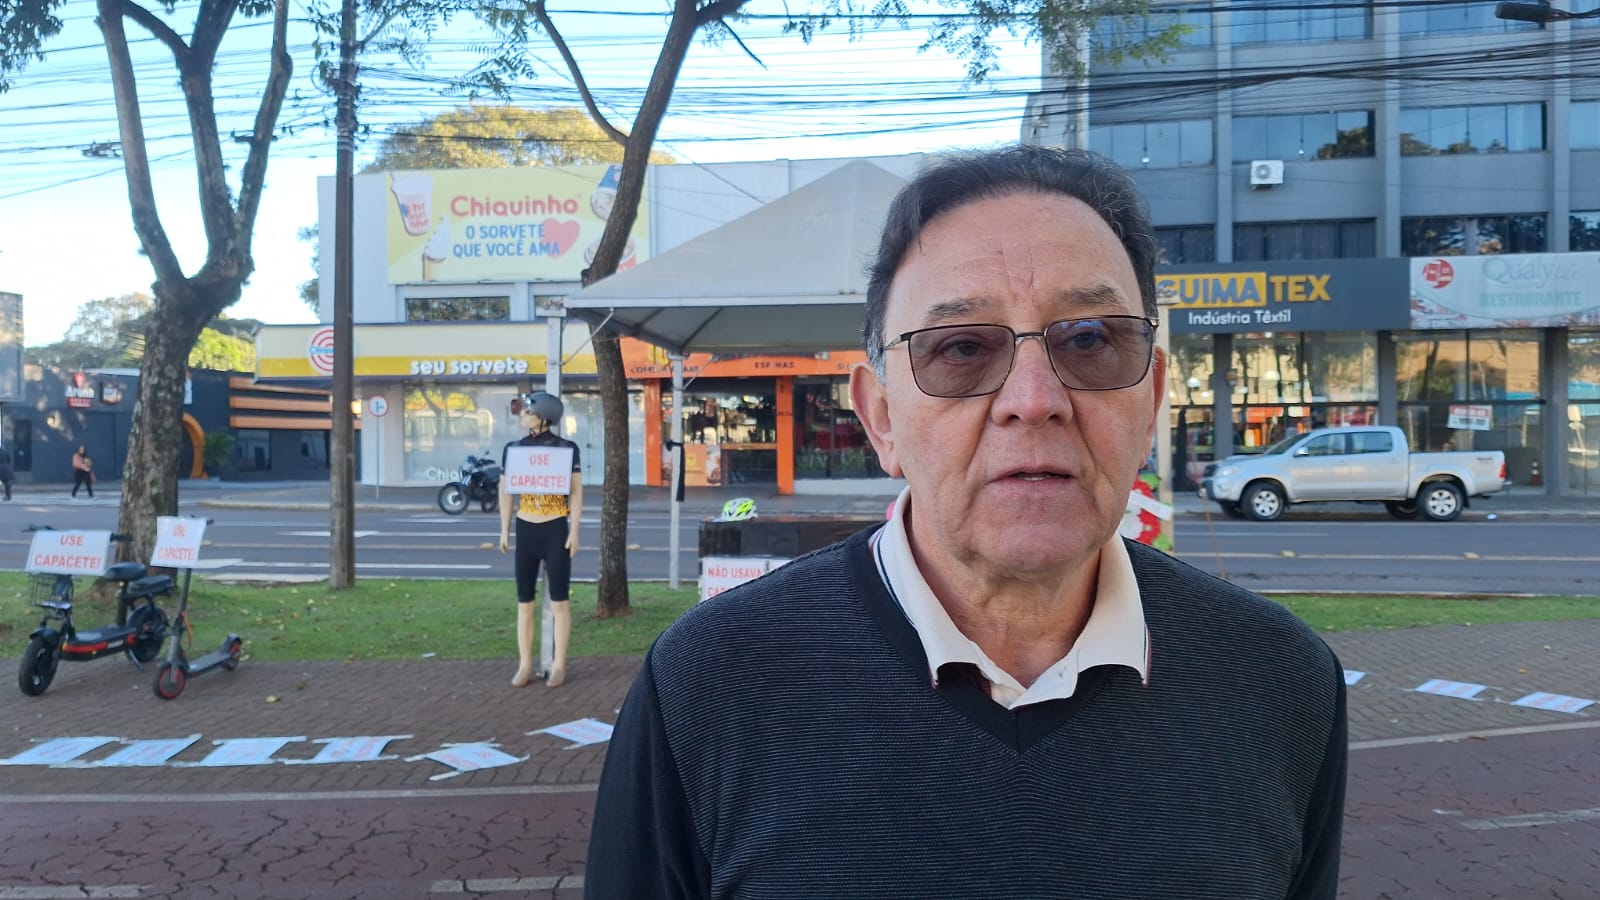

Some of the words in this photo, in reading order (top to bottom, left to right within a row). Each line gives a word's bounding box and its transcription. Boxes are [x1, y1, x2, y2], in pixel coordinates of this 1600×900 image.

[450, 194, 579, 217] Chiquinho
[465, 225, 475, 239] O
[479, 223, 545, 239] SORVETE
[453, 243, 482, 258] QUE
[486, 240, 524, 257] VOCÊ
[528, 241, 560, 256] AMA
[1269, 274, 1331, 303] TEX
[1188, 311, 1250, 326] Indústria
[1254, 308, 1292, 324] Têxtil
[410, 359, 446, 376] seu
[451, 355, 529, 376] sorvete
[529, 453, 550, 466] USE
[510, 475, 566, 489] CAPACETE!
[60, 534, 85, 547] USE
[34, 553, 101, 570] CAPACETE!
[708, 565, 728, 579] NÃO
[731, 567, 763, 579] USAVA
